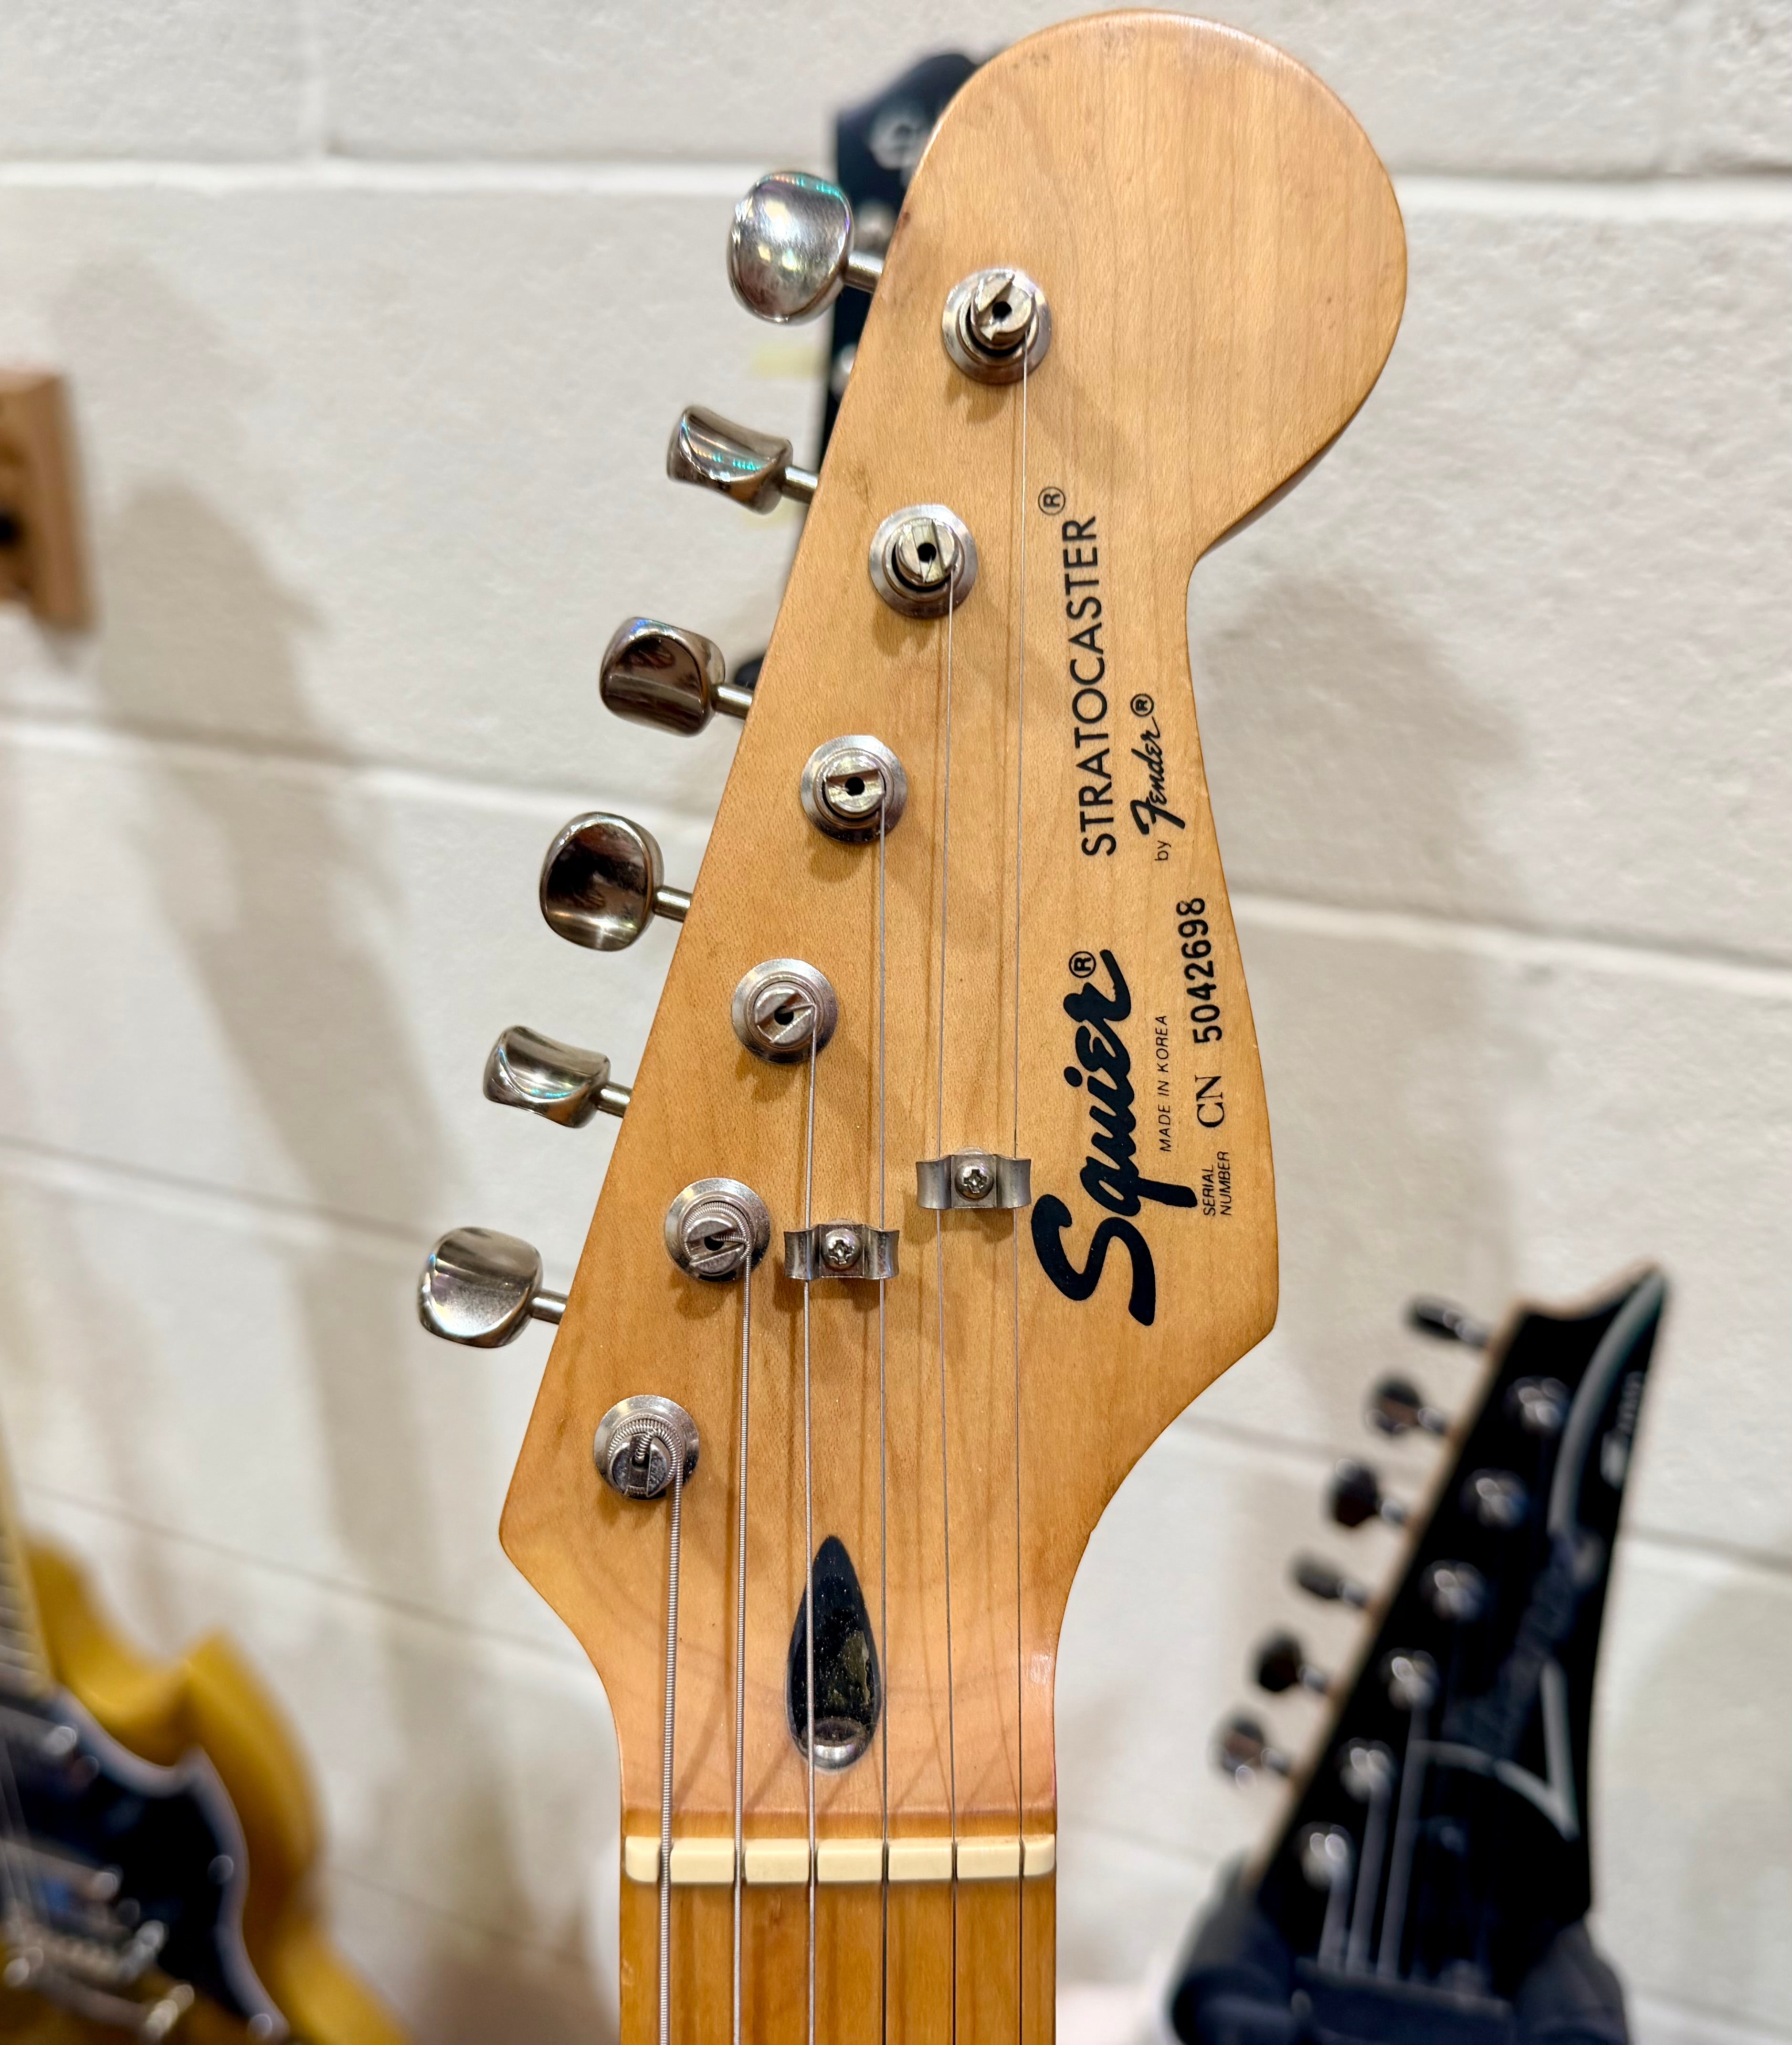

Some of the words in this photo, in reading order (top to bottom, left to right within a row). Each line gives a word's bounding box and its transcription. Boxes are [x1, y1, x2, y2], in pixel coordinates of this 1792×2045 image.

[1154, 840, 1171, 861] by
[1176, 897, 1223, 1044] 5042698
[1155, 1015, 1169, 1073] KOREA
[1157, 1080, 1170, 1096] IN
[1194, 1075, 1225, 1128] CN
[1158, 1103, 1171, 1152] MADE
[1202, 1164, 1216, 1216] SERIAL
[1217, 1151, 1232, 1216] NUMBER
